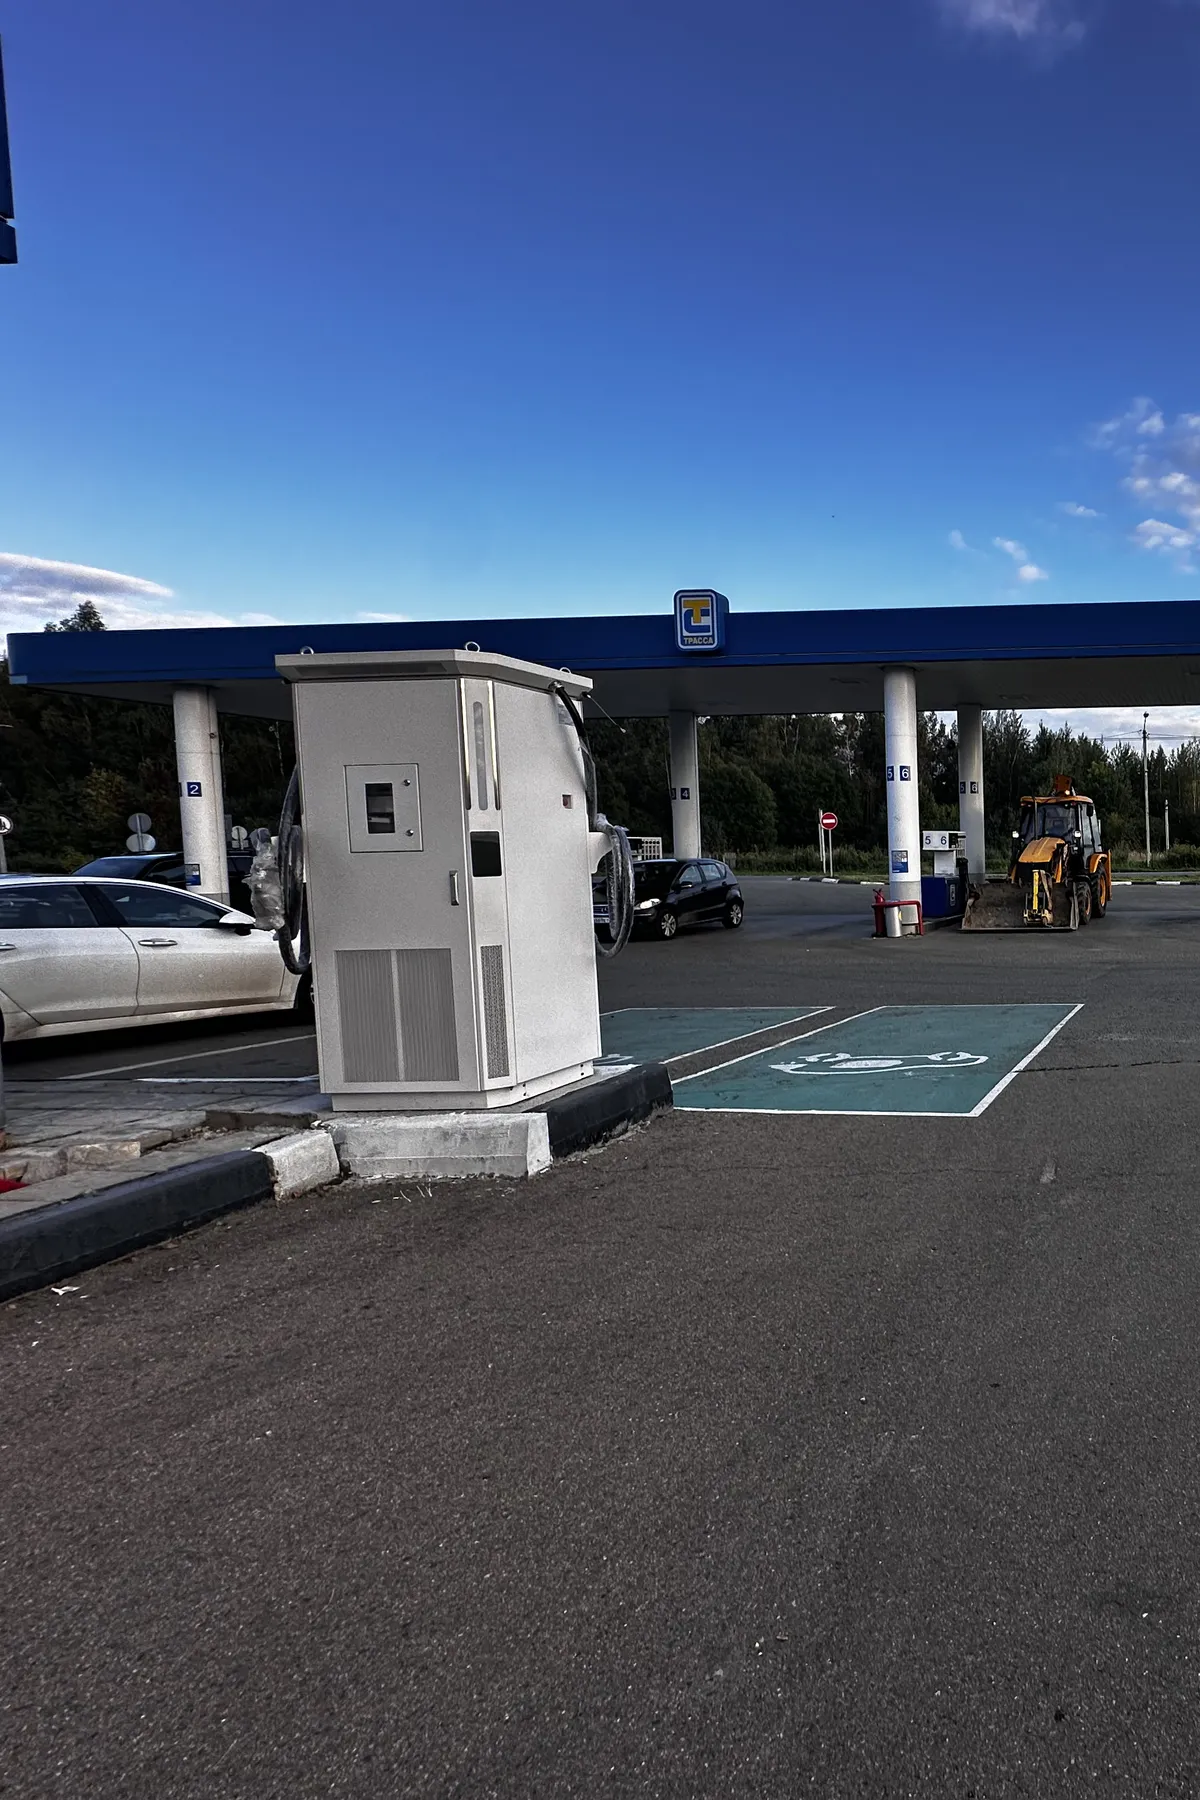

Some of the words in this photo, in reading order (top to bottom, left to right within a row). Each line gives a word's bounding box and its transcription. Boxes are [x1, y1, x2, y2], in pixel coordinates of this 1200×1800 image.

[887, 768, 893, 778] 5
[902, 768, 909, 778] 6
[190, 784, 200, 795] 2
[972, 783, 978, 792] 6
[682, 789, 689, 798] 4
[925, 835, 931, 845] 5
[940, 835, 947, 845] 6
